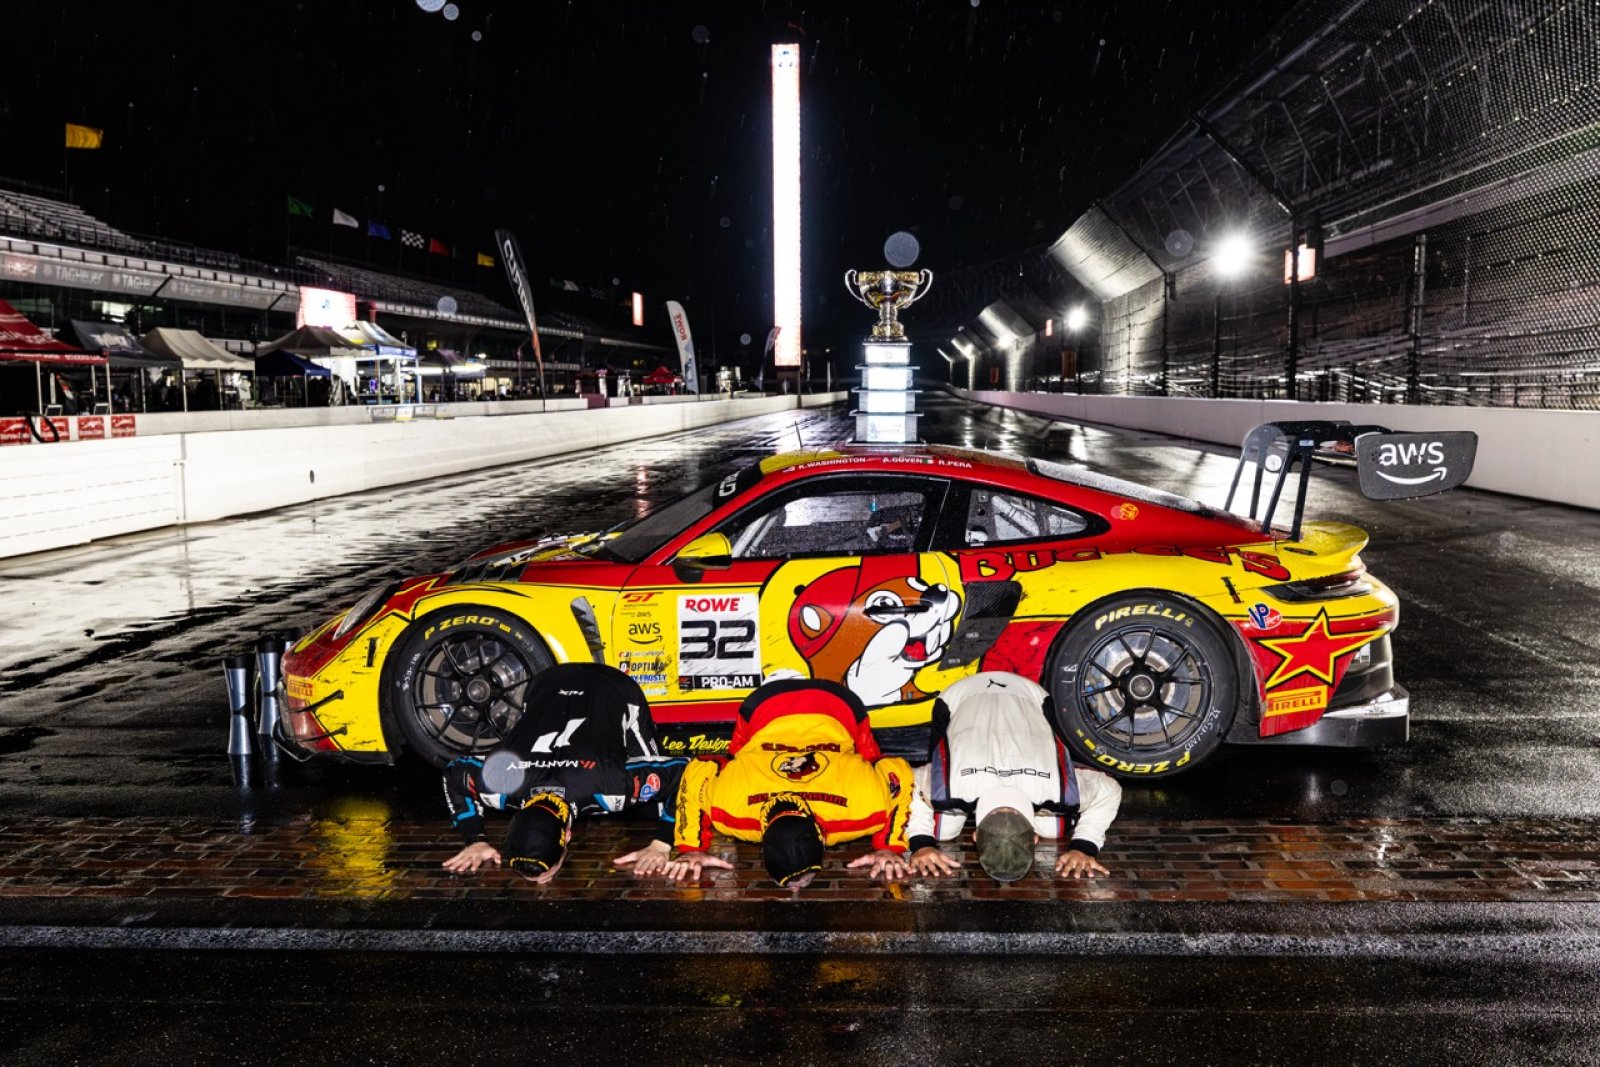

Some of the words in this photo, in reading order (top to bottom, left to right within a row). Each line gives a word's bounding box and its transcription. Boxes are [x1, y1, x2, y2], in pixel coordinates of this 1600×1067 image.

[1380, 441, 1445, 467] aws
[938, 460, 972, 468] R.PERA
[685, 597, 741, 612] ROWE
[1094, 604, 1187, 631] PIRELLI
[1248, 603, 1271, 629] VP
[424, 626, 436, 641] P
[439, 615, 494, 631] ZERO
[628, 621, 661, 636] aws
[679, 619, 756, 660] 32
[701, 675, 754, 688] PRO-AM
[1267, 697, 1321, 712] PIRELLI
[505, 760, 578, 772] MANTHEY
[1098, 754, 1171, 774] ZERO
[1175, 751, 1191, 767] P
[960, 766, 1051, 779] PORSCHE
